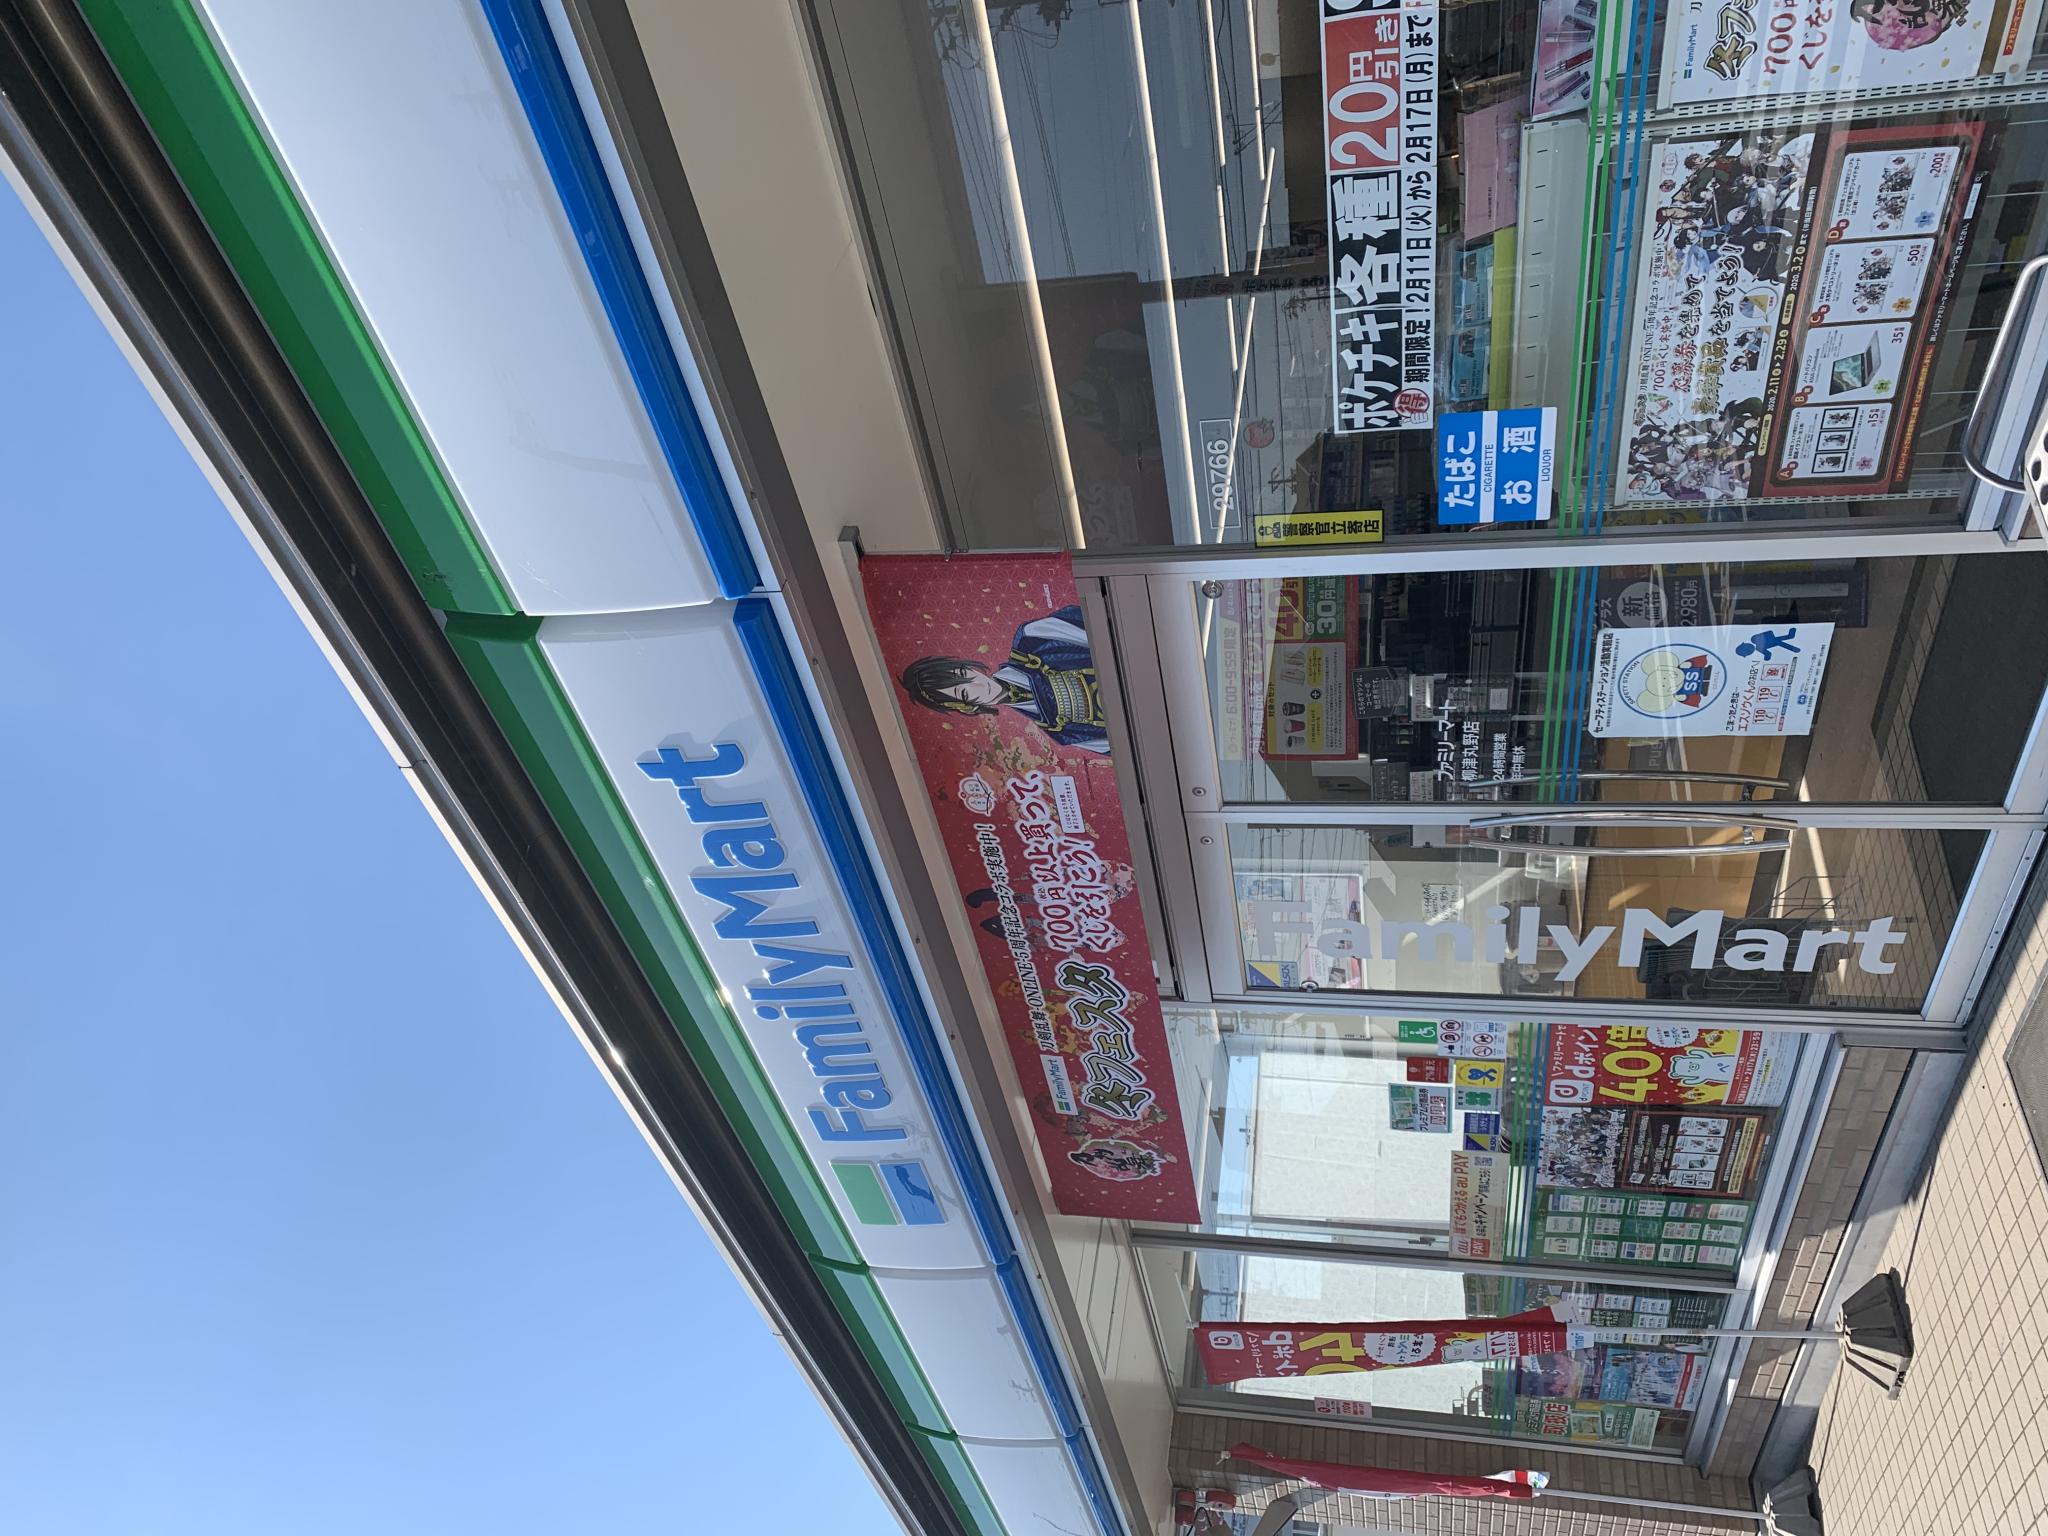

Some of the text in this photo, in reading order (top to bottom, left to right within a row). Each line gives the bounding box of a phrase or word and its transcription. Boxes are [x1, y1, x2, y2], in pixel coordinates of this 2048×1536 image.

[1684, 23, 1699, 67] FamilyMart
[1671, 273, 1706, 393] 応募券を集めて
[1206, 438, 1235, 511] 29766
[1443, 431, 1477, 508] たばこ
[1483, 443, 1494, 493] CIGARETTE
[1540, 448, 1552, 483] LIQUOR
[1282, 519, 1380, 536] 警察官立寄店
[1621, 596, 1644, 617] 新
[1643, 590, 1661, 622] 価格
[1622, 660, 1640, 705] SAFETY STATION
[1684, 671, 1699, 692] SS
[1757, 687, 1770, 702] 119
[1754, 709, 1767, 724] 110
[1437, 698, 1458, 782] ファミリーマート
[1461, 720, 1480, 782] 柳津丸野店
[1492, 732, 1508, 782] 24時間営業
[1510, 745, 1527, 782] 年中無休
[634, 742, 908, 1141] FamilyMart
[1256, 899, 1908, 982] FamilyMart
[1061, 962, 1146, 1117] 冬フェスタ
[1048, 1058, 1069, 1100] FamilyMart
[1716, 1062, 1730, 1073] ペ
[1419, 1088, 1429, 1132] プレミアム付商品券
[1429, 1095, 1447, 1125] 取扱店
[1453, 1154, 1469, 1175] PAY
[1456, 1176, 1469, 1189] au
[1457, 1240, 1469, 1254] au
[1472, 1240, 1483, 1255] PAY
[1542, 1402, 1570, 1435] 取扱店
